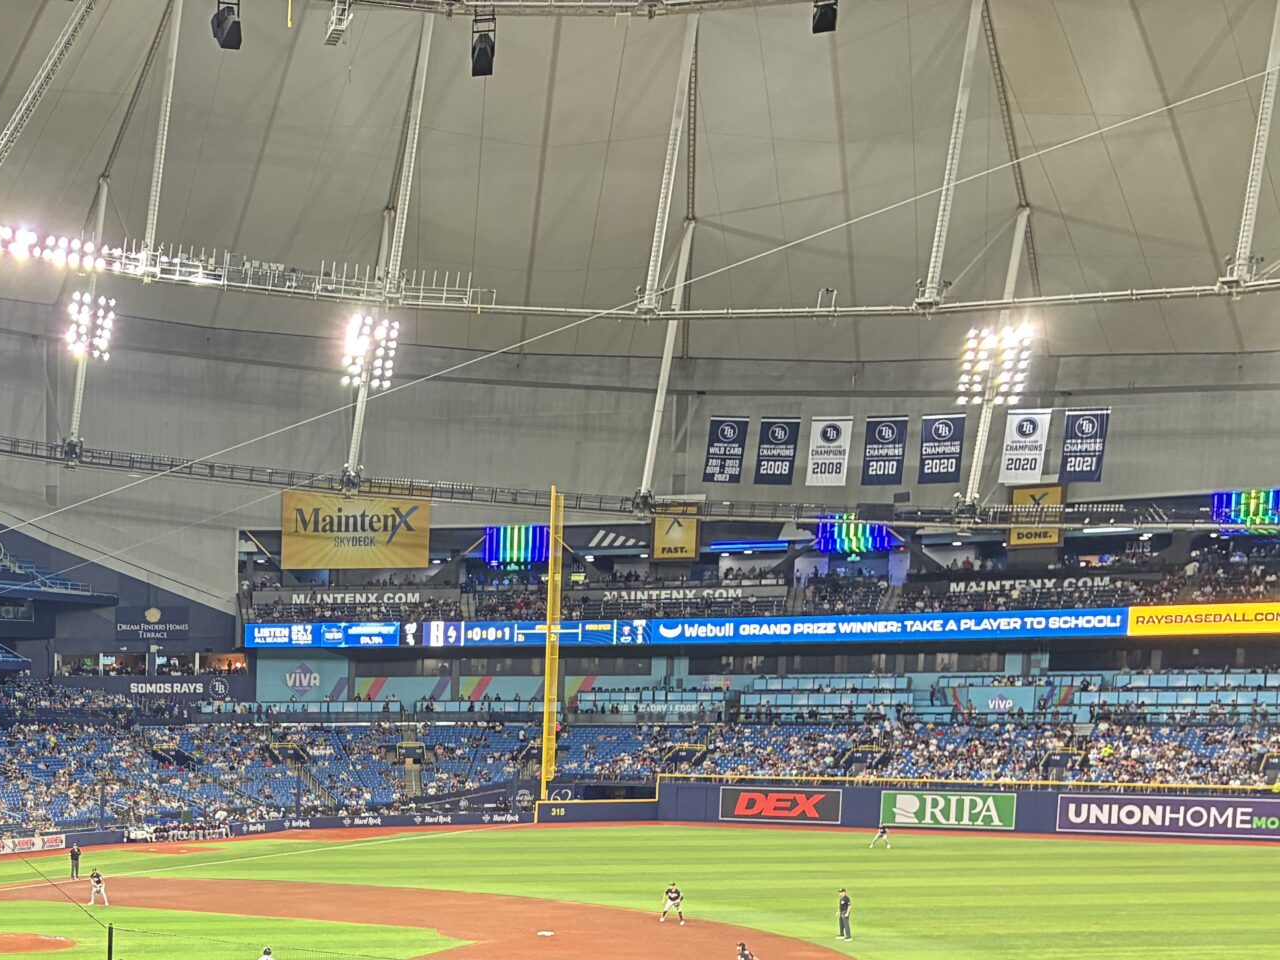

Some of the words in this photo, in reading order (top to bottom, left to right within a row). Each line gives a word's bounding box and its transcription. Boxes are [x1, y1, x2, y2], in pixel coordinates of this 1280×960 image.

[709, 447, 724, 455] WILD
[759, 448, 794, 457] CHAMPIONS
[866, 448, 903, 457] CHAMPIONS
[922, 445, 960, 454] CHAMPIONS
[1005, 444, 1043, 452] CHAMPIONS
[1063, 443, 1102, 452] CHAMPIONS
[811, 449, 846, 457] CHAMPIONS
[760, 462, 790, 474] 2008
[812, 462, 842, 475] 2008
[869, 461, 897, 475] 2010
[924, 459, 956, 473] 2020
[1006, 458, 1037, 471] 2020
[1066, 457, 1096, 471] 2021
[294, 505, 419, 545] MaintenX
[1016, 531, 1052, 540] DONE.
[333, 536, 376, 548] SKYDECK
[661, 546, 687, 554] FAST.
[117, 623, 140, 631] DREAM
[141, 623, 166, 631] FINDERS
[167, 623, 189, 631] HOMES
[684, 623, 734, 637] Webull
[739, 623, 791, 636] GRAND
[793, 622, 836, 635] PRIZE
[839, 620, 902, 634] WINNER:
[904, 619, 943, 632] TAKE
[945, 619, 958, 631] A
[960, 617, 1021, 631] PLAYER
[1024, 617, 1046, 629] TO
[1048, 615, 1122, 629] SCHOOL!
[130, 683, 172, 693] SOMOS
[173, 683, 203, 693] RAYS
[734, 792, 826, 818] DEX
[922, 794, 1003, 826] RIPA
[551, 807, 565, 816] 315
